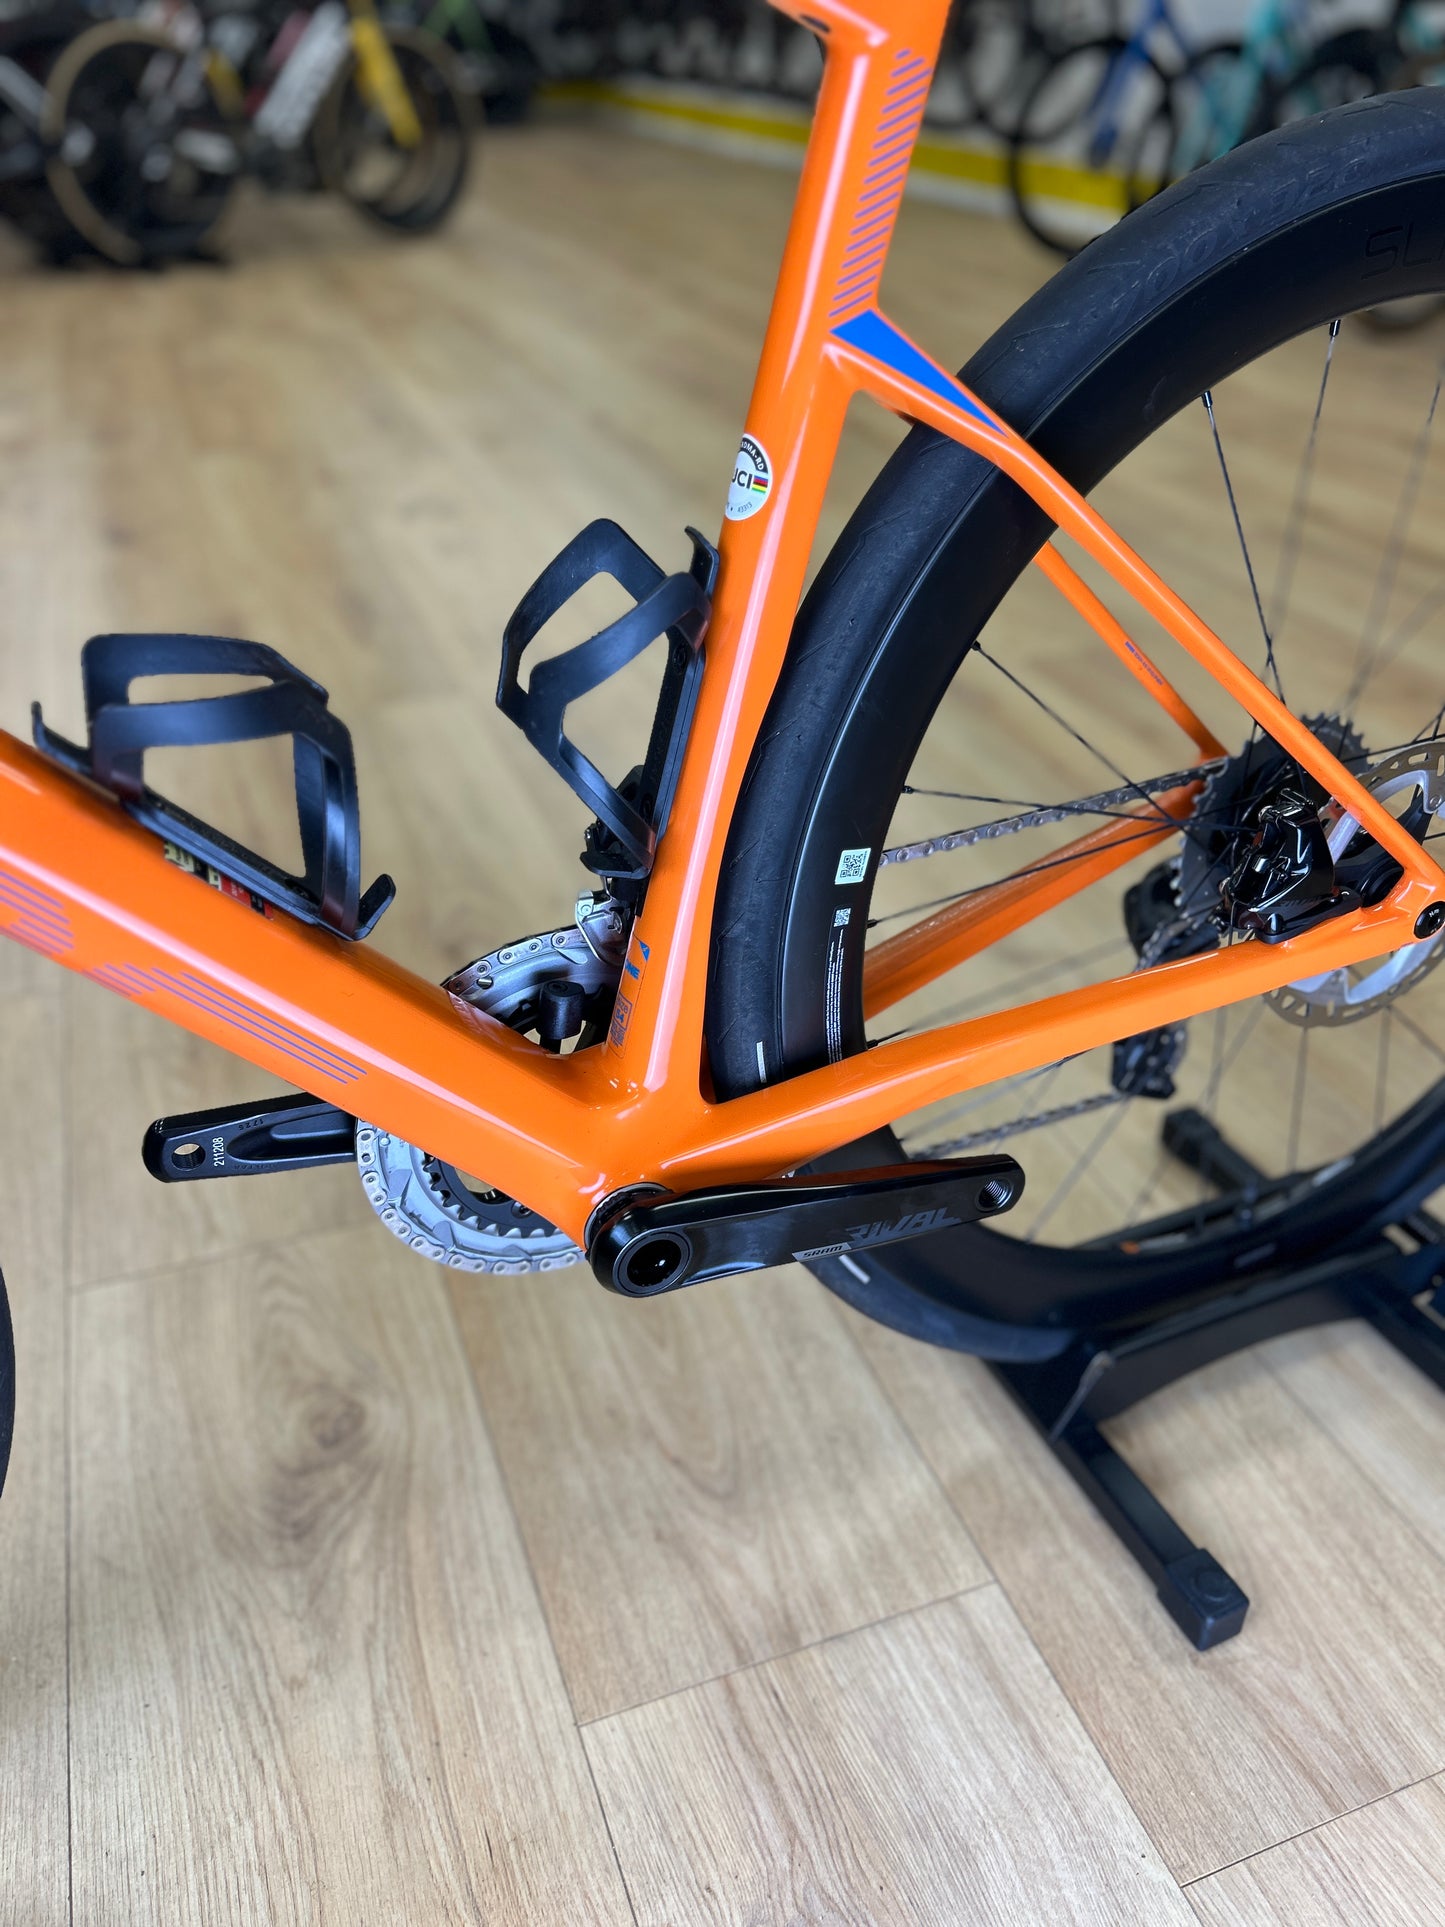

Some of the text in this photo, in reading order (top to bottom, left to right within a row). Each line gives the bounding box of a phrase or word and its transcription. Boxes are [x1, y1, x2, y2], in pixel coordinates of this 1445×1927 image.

[213, 1136, 225, 1167] 211208
[845, 1207, 962, 1247] RIVAL
[803, 1245, 843, 1258] SRAM
